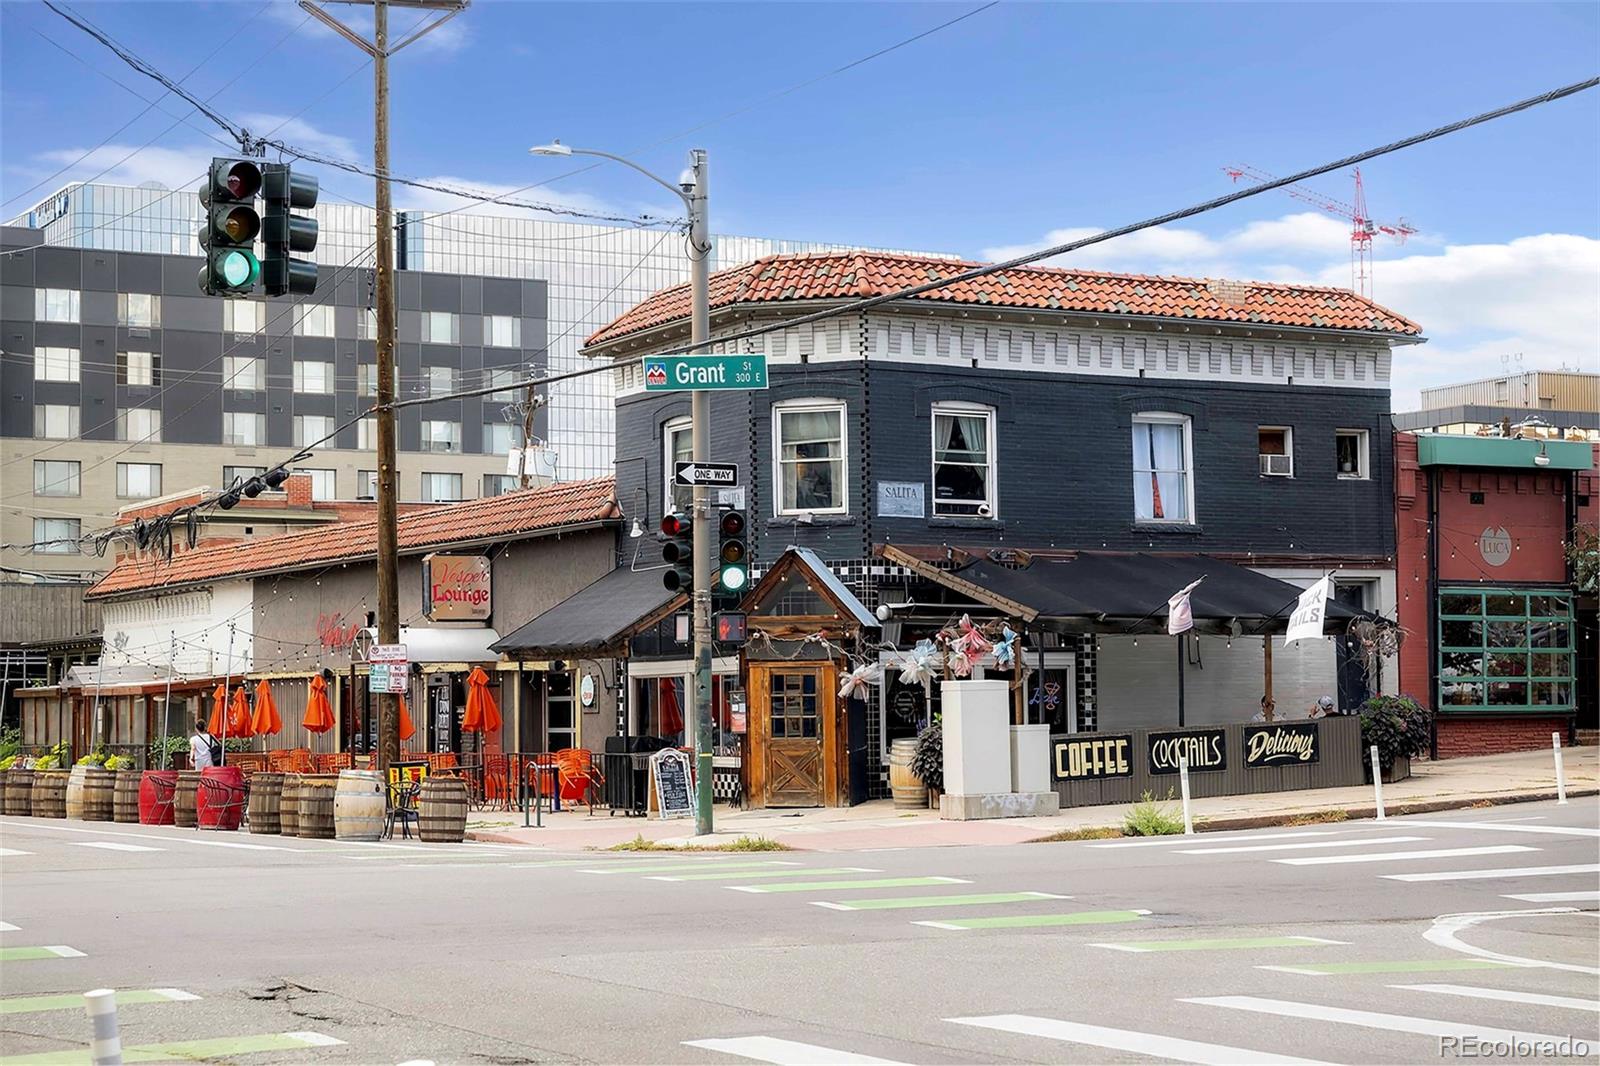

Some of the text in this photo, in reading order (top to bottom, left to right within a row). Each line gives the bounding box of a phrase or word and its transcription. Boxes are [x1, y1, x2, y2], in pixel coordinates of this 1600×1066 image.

[675, 362, 725, 384] Grant
[742, 361, 752, 370] St
[735, 372, 760, 382] 300 E
[694, 469, 731, 479] ONE WAY
[885, 486, 918, 499] SALITA
[1483, 539, 1510, 554] LUCA
[432, 584, 489, 606] Lounge
[1247, 728, 1314, 763] Delicious
[1055, 739, 1129, 778] COFFEE
